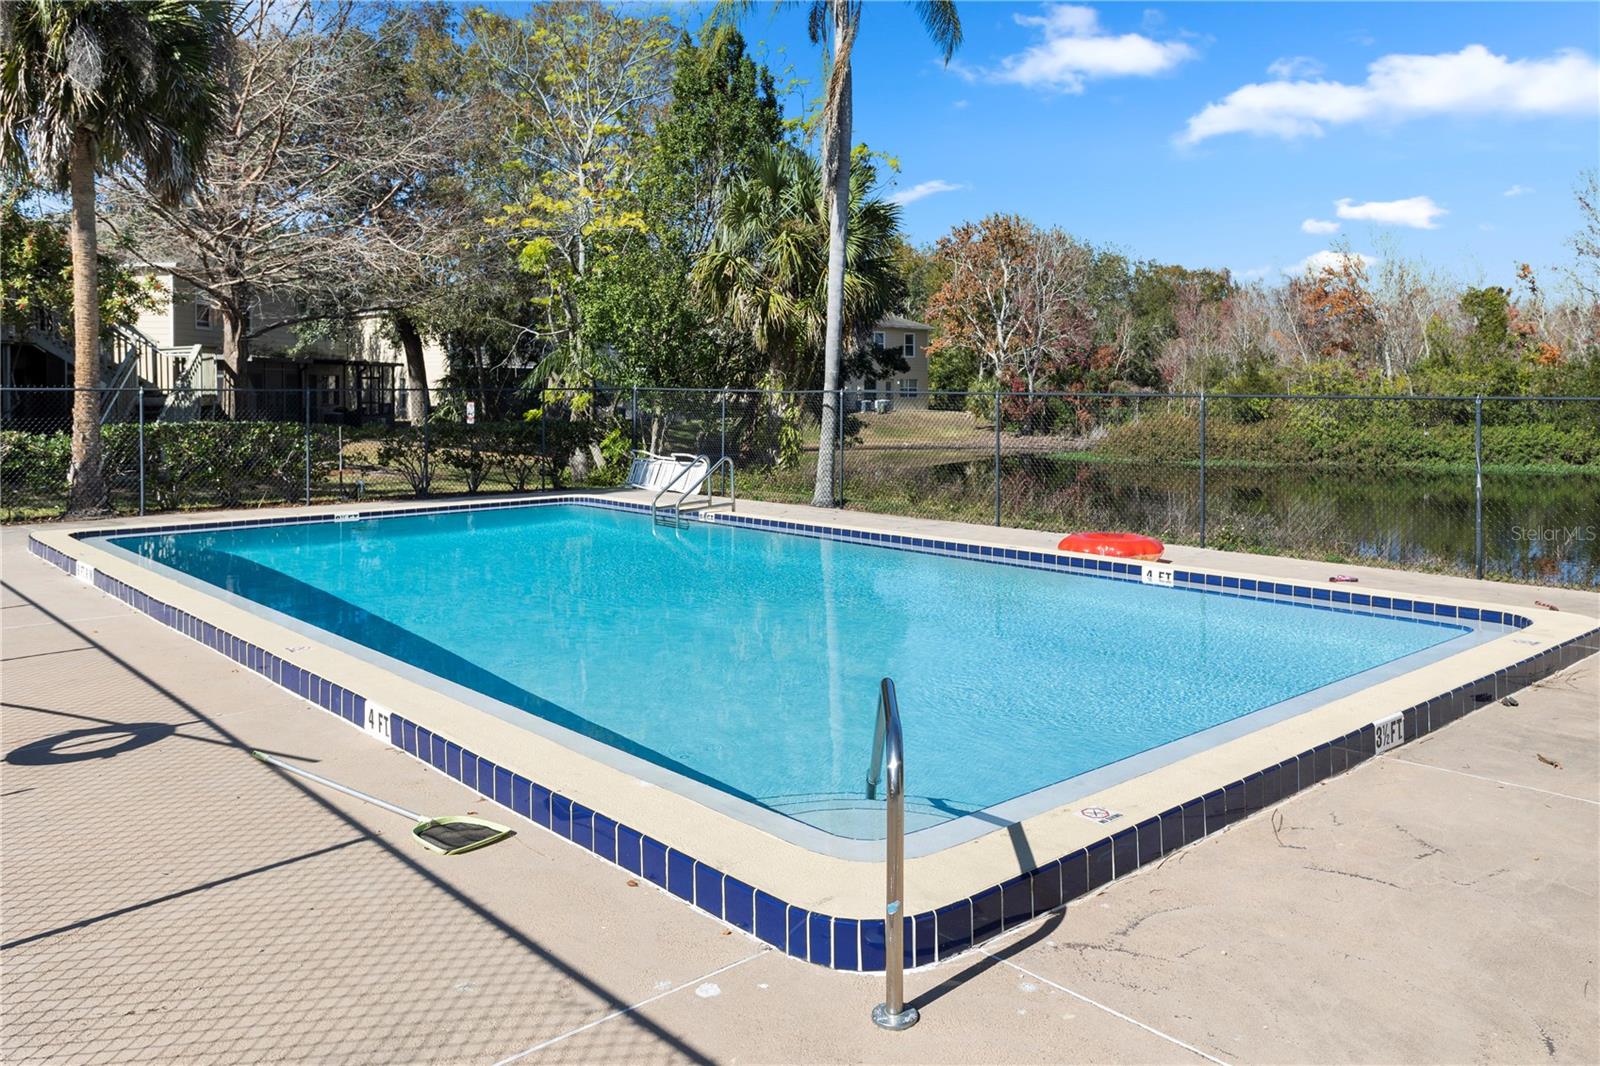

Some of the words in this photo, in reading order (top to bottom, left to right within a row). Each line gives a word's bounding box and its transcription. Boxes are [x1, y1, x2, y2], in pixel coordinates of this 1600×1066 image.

[368, 708, 374, 729] 4
[378, 712, 390, 737] FT
[1390, 718, 1403, 742] FT
